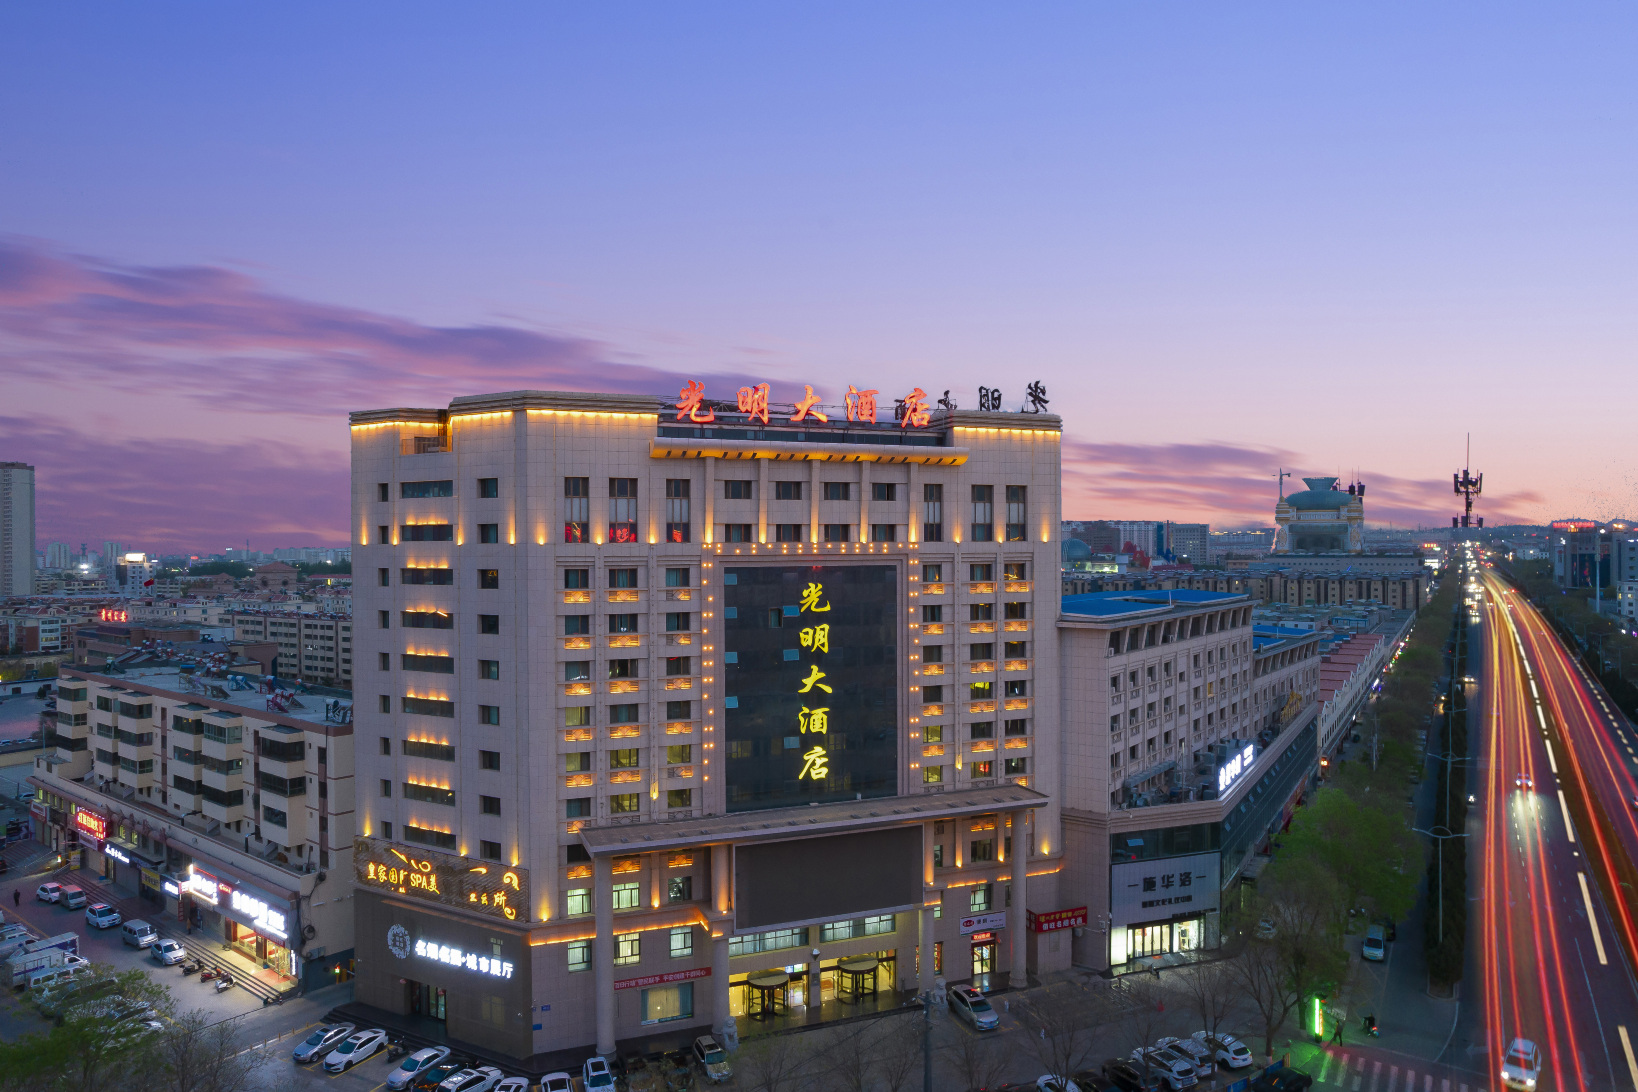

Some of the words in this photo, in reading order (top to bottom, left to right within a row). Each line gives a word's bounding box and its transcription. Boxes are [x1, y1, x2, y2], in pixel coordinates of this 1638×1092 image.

[675, 379, 931, 428] 光明大酒店
[798, 582, 833, 780] 光明大酒店
